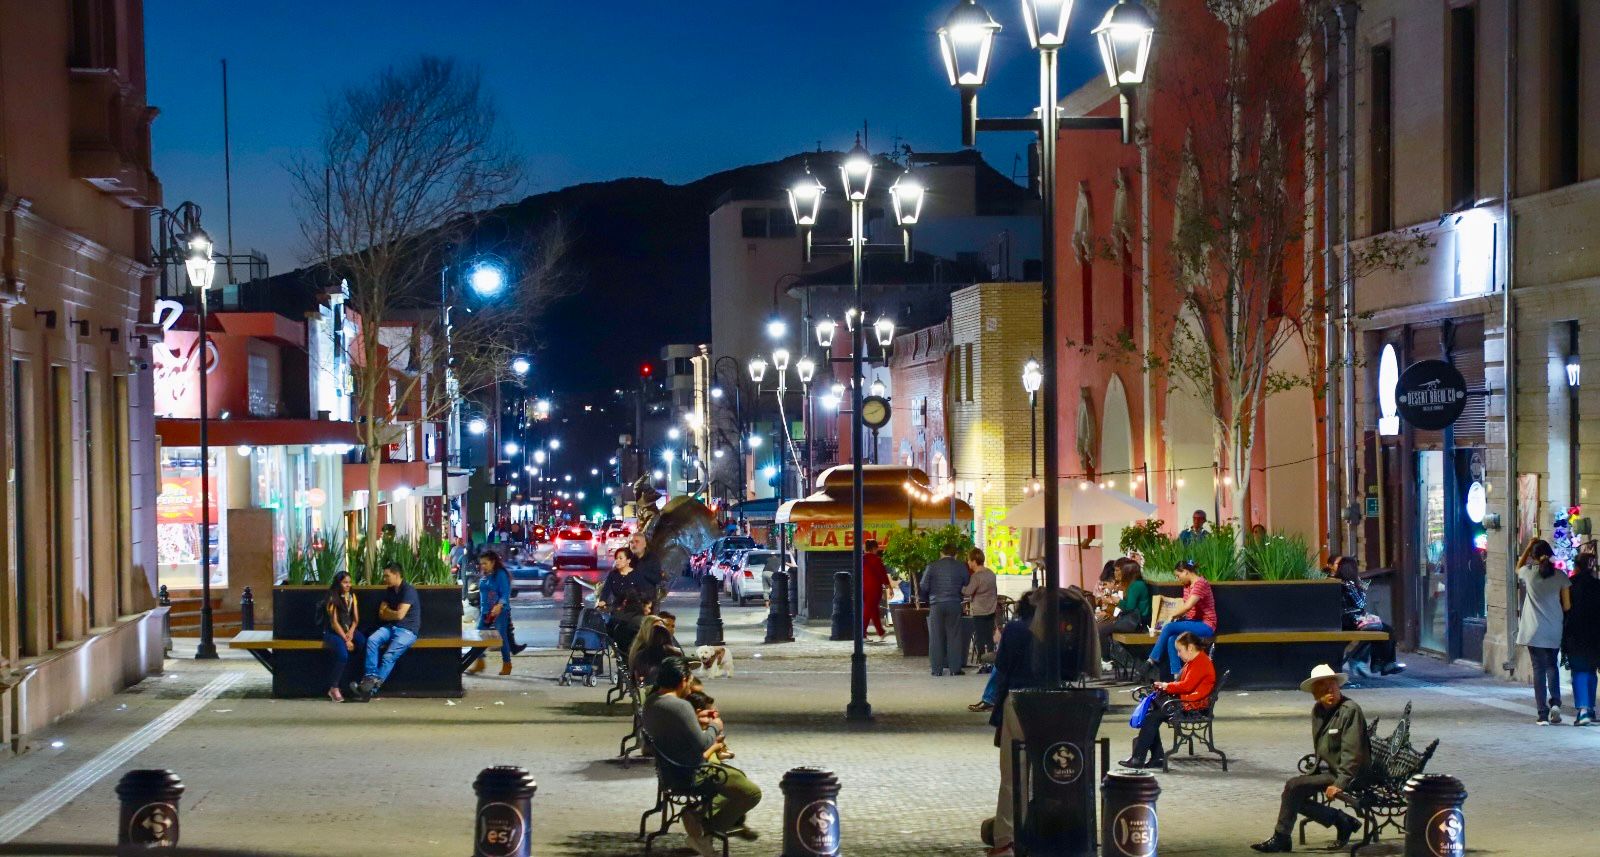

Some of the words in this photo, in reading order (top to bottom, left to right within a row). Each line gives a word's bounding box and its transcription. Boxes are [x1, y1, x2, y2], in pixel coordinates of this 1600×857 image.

[1407, 390, 1428, 405] DESERT
[1429, 389, 1446, 404] BREW
[810, 530, 839, 547] LA
